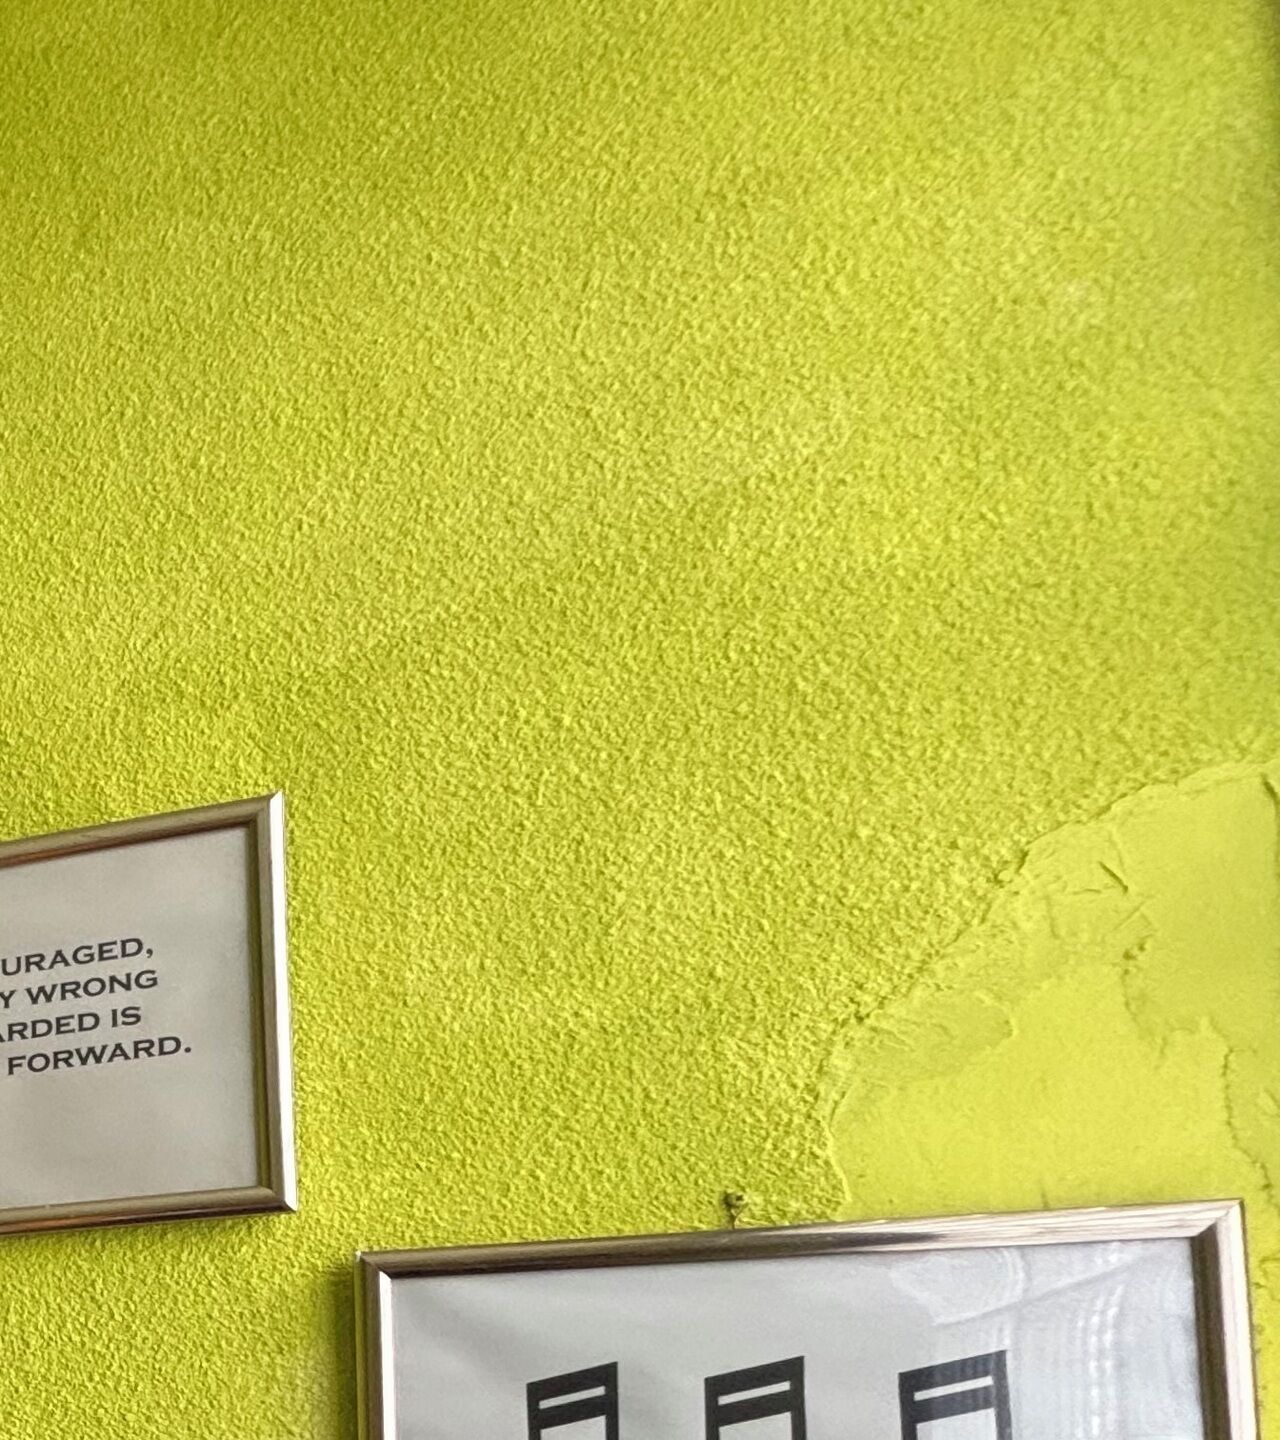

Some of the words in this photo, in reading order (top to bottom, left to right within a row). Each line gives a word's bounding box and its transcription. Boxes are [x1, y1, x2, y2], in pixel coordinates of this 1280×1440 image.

[24, 969, 159, 1005] WRONG
[111, 1006, 142, 1028] IS
[7, 1036, 192, 1076] FORWARD.
